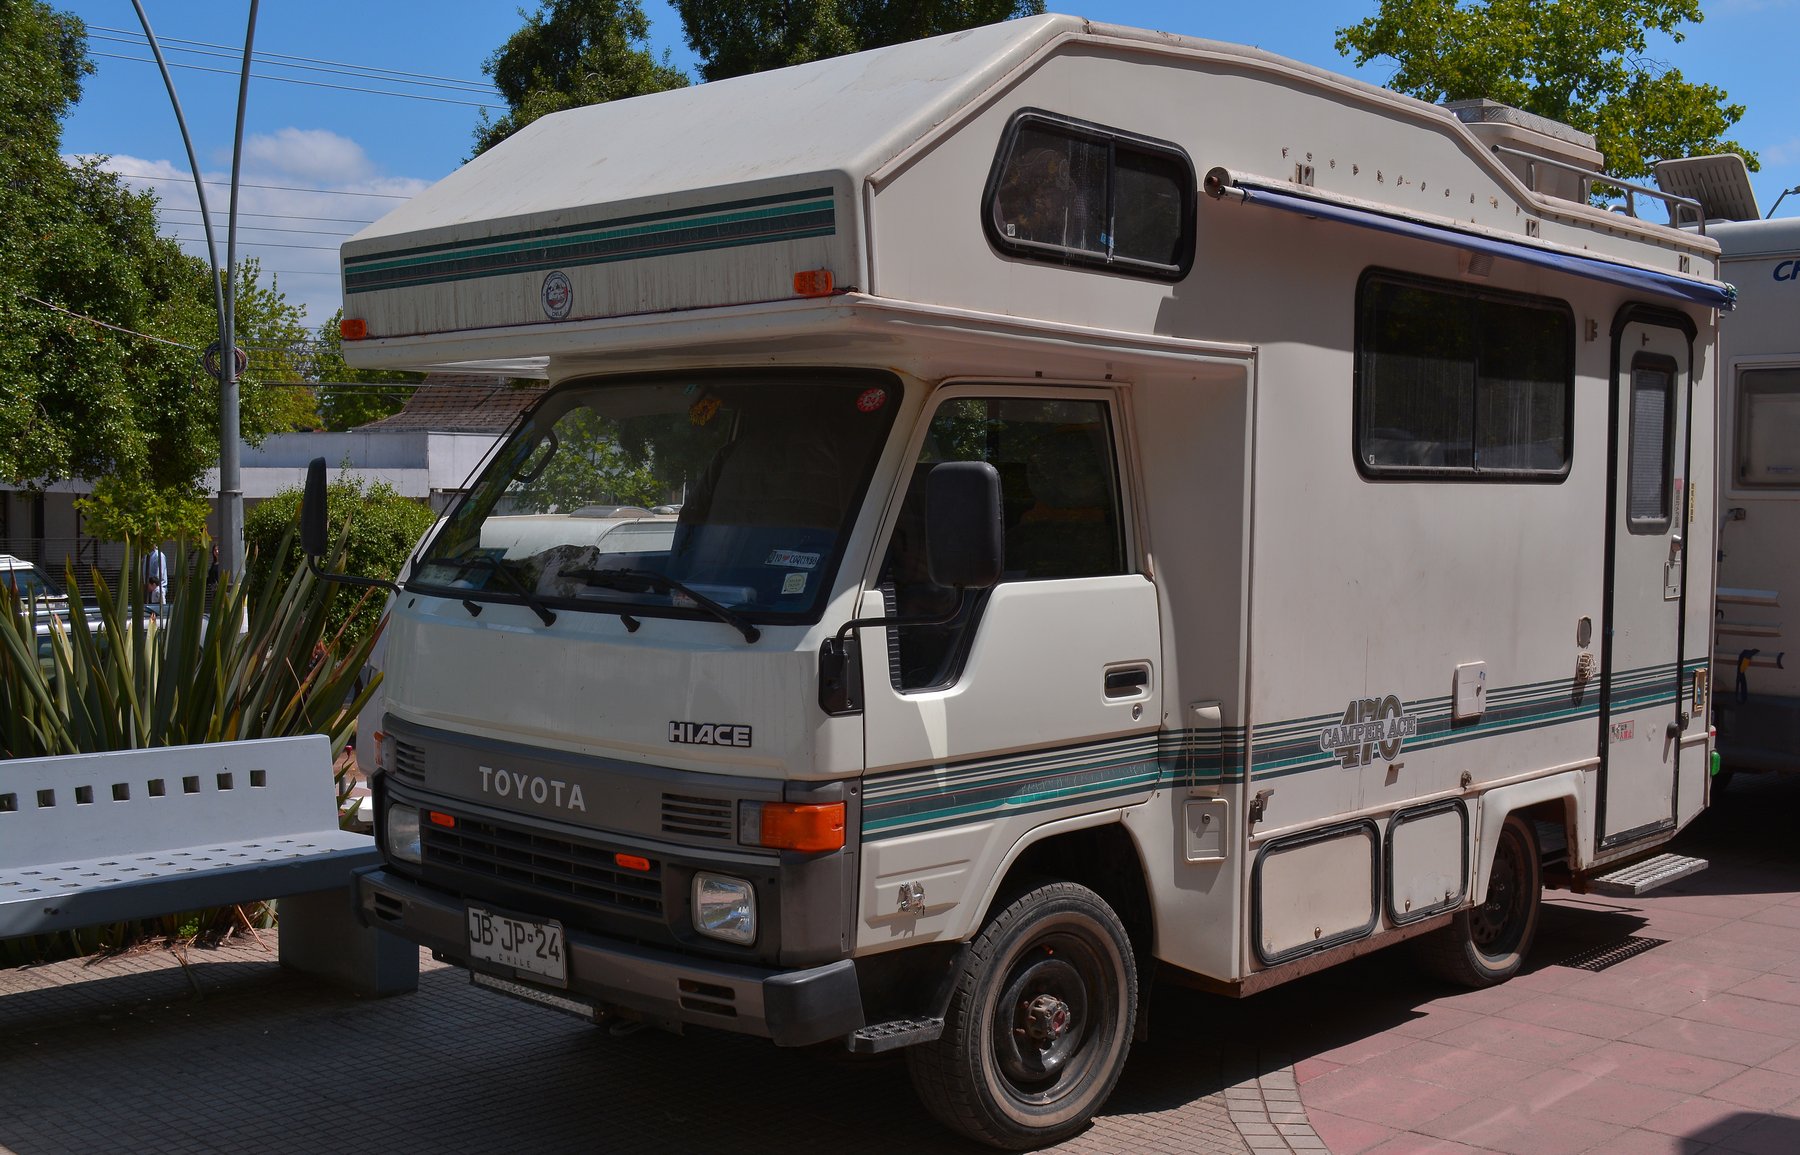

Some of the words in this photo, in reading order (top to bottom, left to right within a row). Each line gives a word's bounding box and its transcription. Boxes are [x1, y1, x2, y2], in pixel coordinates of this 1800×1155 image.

[668, 721, 752, 747] HIACE
[1320, 720, 1385, 750] CAMPER
[1387, 715, 1416, 739] ACE
[1334, 694, 1404, 769] 470
[479, 766, 586, 812] TOYOTA
[498, 953, 531, 969] CHILE
